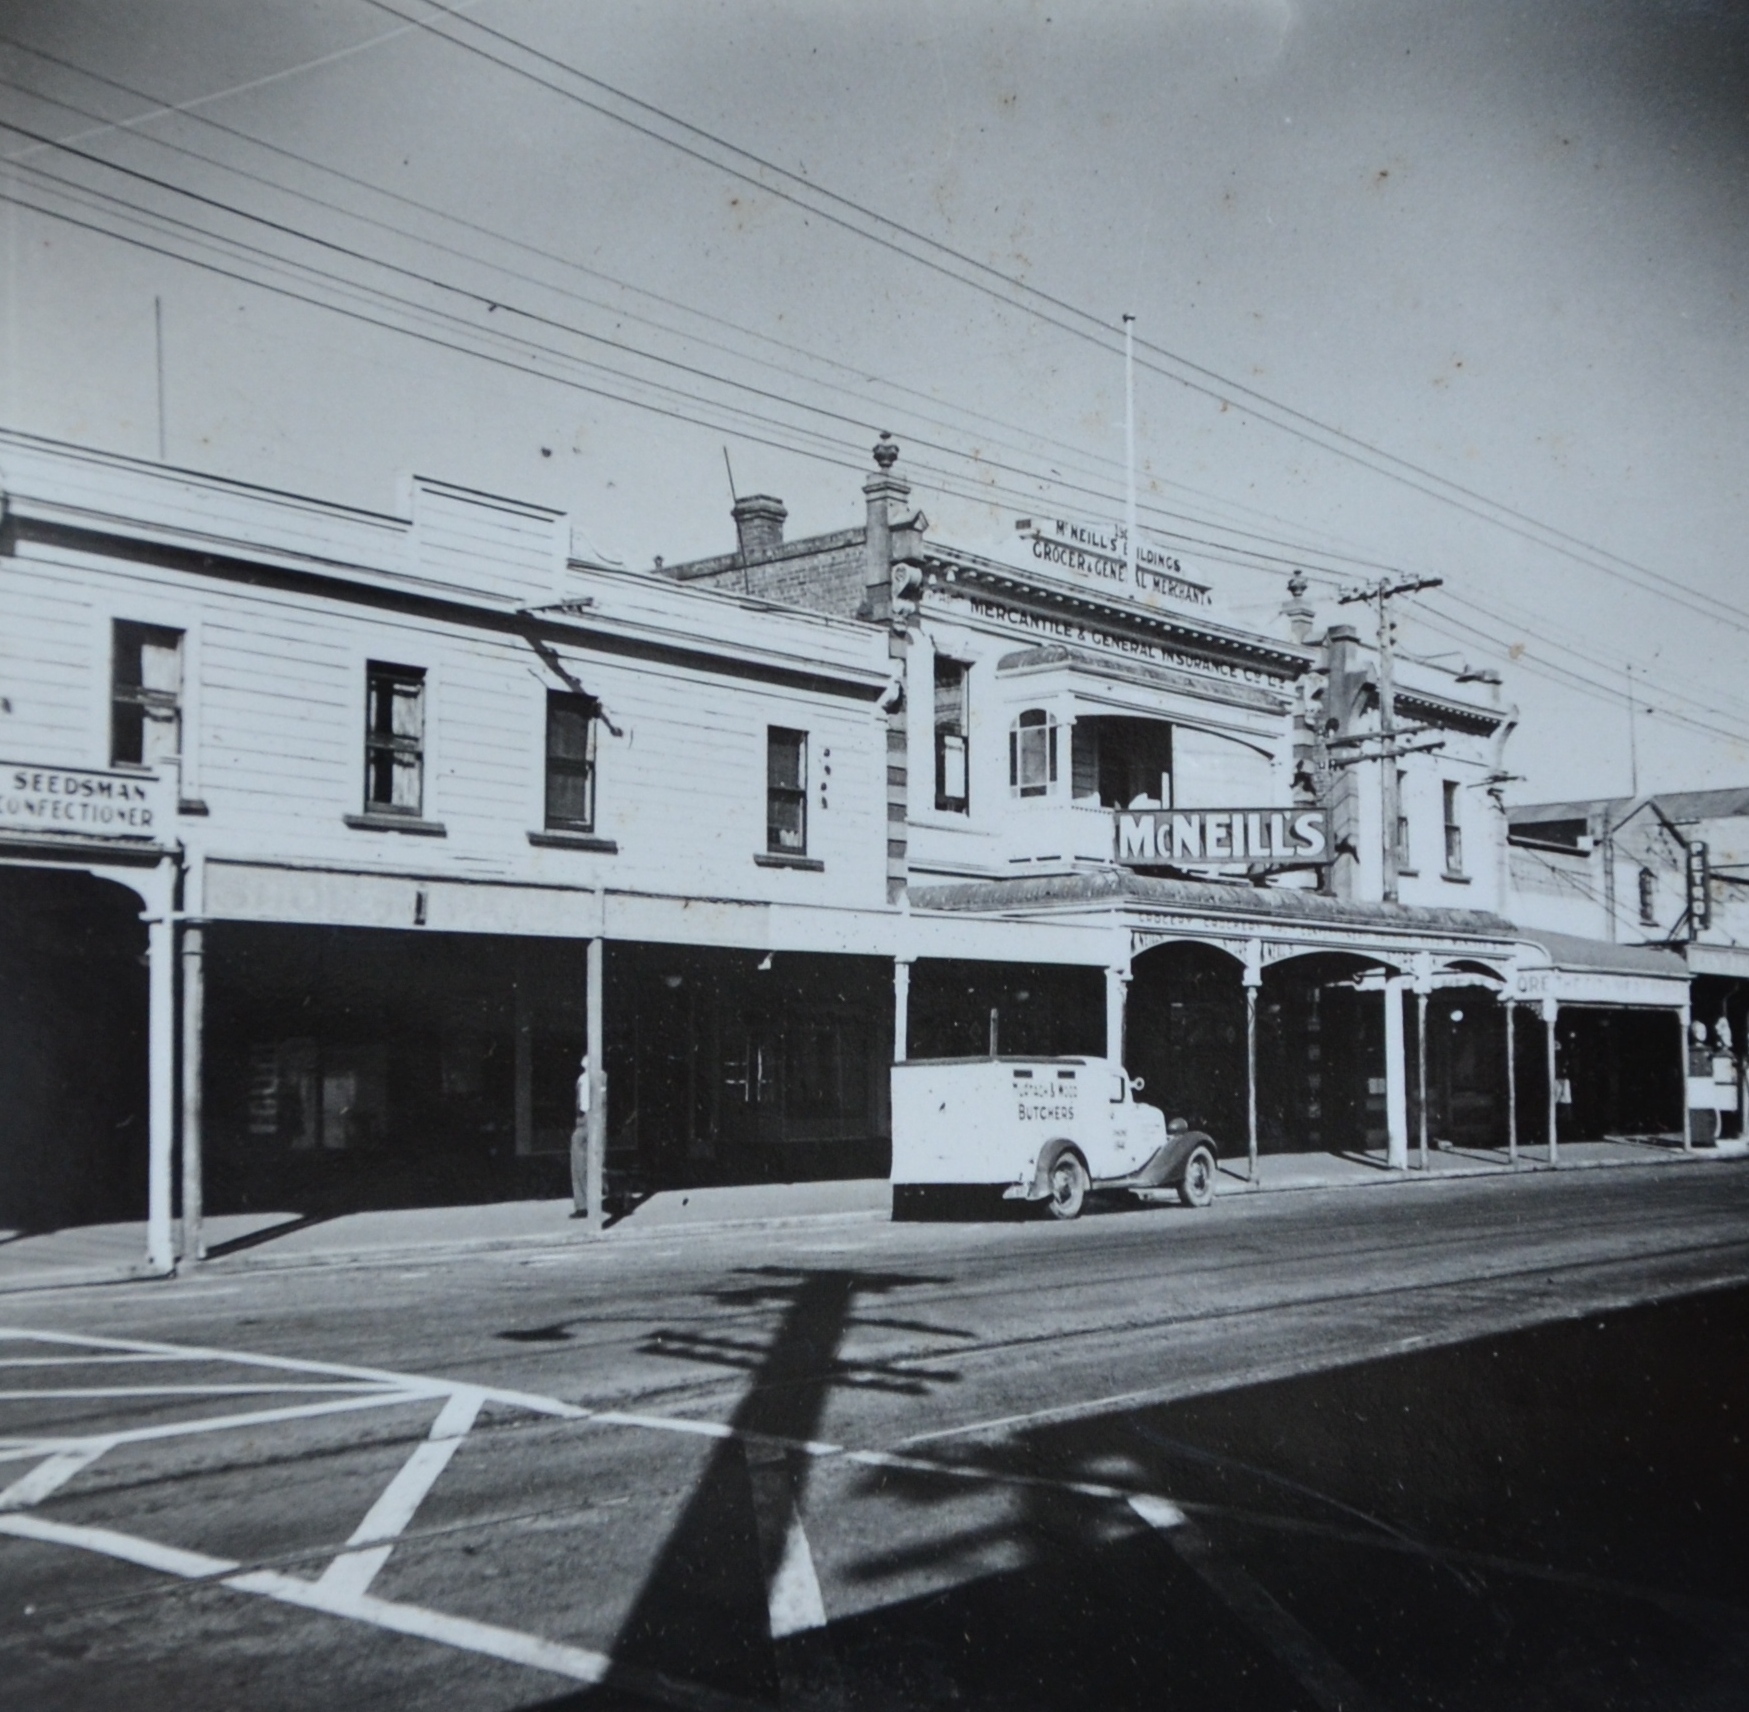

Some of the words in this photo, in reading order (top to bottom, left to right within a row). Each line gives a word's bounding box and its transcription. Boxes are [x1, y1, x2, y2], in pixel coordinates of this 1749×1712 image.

[1032, 540, 1086, 571] GROCER
[1094, 559, 1147, 589] GENEL
[1123, 542, 1181, 573] ILDINGS
[970, 597, 1073, 638] MERCANTILE
[1077, 626, 1086, 641] &
[1091, 631, 1156, 659] GENERAL
[1161, 645, 1238, 679] INSURANCE
[14, 771, 147, 801] SEEDSMAN
[0, 795, 153, 827] ONFECTIONER
[1119, 811, 1326, 858] McNEILL'S
[1689, 841, 1705, 930] PETROL
[1018, 1103, 1075, 1121] BUTCHERS
